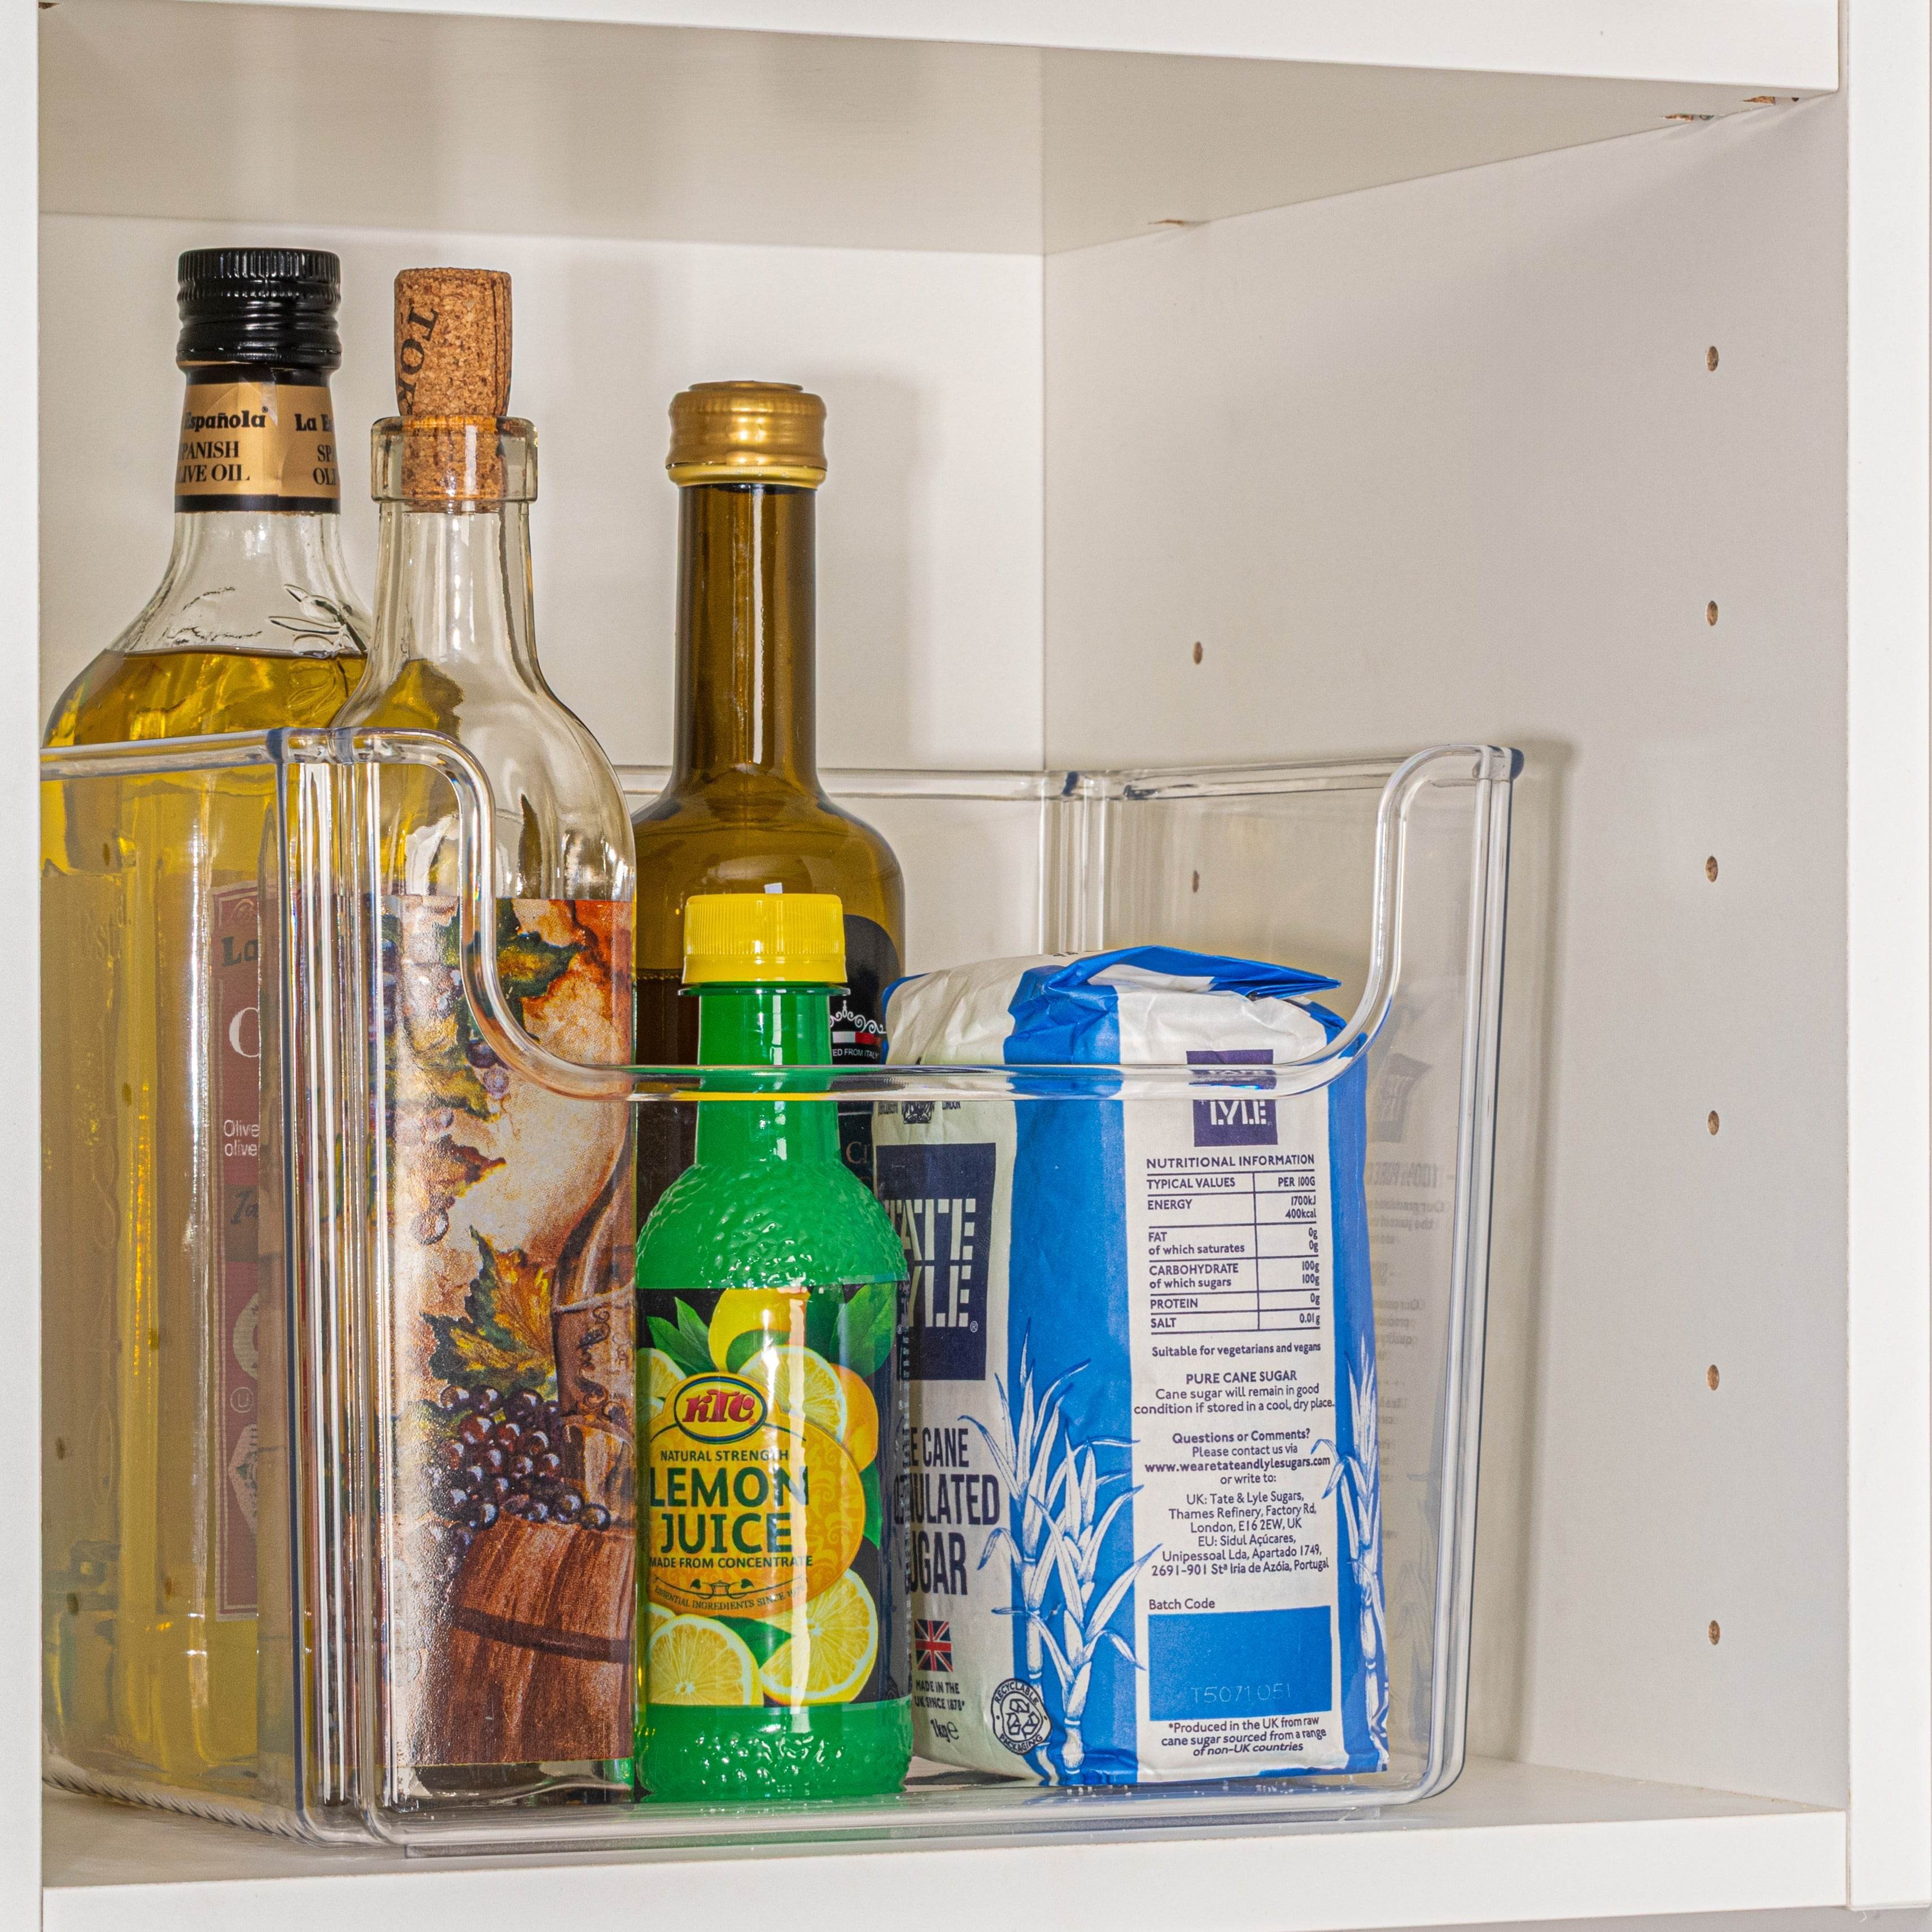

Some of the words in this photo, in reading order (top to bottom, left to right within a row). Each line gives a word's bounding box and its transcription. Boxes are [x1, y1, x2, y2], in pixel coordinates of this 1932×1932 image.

[294, 413, 317, 431] La
[211, 464, 250, 481] OIL
[844, 1048, 864, 1056] FROM
[864, 1050, 878, 1059] ITALY
[1210, 1100, 1266, 1125] LYLE
[1146, 1156, 1236, 1169] NUTRITIONAL
[1239, 1154, 1314, 1166] INFORMATION
[1146, 1178, 1194, 1190] TYPICAL
[1195, 1177, 1235, 1188] VALUES
[1278, 1177, 1295, 1187] PER
[1298, 1176, 1315, 1186] 100G
[1148, 1199, 1192, 1210] ENERGY
[1291, 1195, 1316, 1206] 1700kJ
[1285, 1208, 1317, 1219] 400kcal
[1148, 1231, 1168, 1242] FAT
[1308, 1227, 1318, 1240] 0g
[1148, 1245, 1160, 1256] of
[1162, 1244, 1195, 1255] which
[1197, 1244, 1245, 1254] saturates
[1309, 1240, 1319, 1253] 0g
[1149, 1262, 1239, 1276] CARBOHYDRATE
[1302, 1260, 1319, 1273] 100g
[1149, 1278, 1161, 1289] of
[1164, 1278, 1195, 1288] which
[1198, 1279, 1231, 1290] sugars
[1302, 1273, 1320, 1286] 100g
[1150, 1298, 1198, 1309] PROTEIN
[1310, 1292, 1320, 1306] 0g
[1151, 1317, 1177, 1328] SALT
[1299, 1313, 1320, 1326] 0.01g
[1152, 1345, 1197, 1357] Suitable
[1200, 1345, 1215, 1356] for
[1217, 1344, 1274, 1358] vegetarians
[1276, 1343, 1292, 1353] and
[1293, 1343, 1321, 1355] vegans
[1186, 1372, 1220, 1384] PURE
[1223, 1371, 1257, 1383] CANE
[1259, 1370, 1297, 1382] SUGAR
[1155, 1388, 1187, 1400] Cane
[1190, 1390, 1222, 1402] sugar
[1225, 1386, 1246, 1397] will
[1248, 1388, 1284, 1397] remain
[1296, 1383, 1319, 1398] good
[1134, 1403, 1192, 1414] condition
[1196, 1402, 1204, 1413] if
[1207, 1401, 1244, 1413] stored
[1246, 1401, 1256, 1411] in
[1266, 1399, 1291, 1411] cool,
[1293, 1399, 1309, 1412] dry
[1311, 1398, 1335, 1410] place.
[1172, 1432, 1234, 1444] Questions
[1237, 1433, 1249, 1442] or
[1251, 1428, 1310, 1441] Comments?
[922, 1427, 969, 1467] CANE
[1192, 1446, 1229, 1457] Please
[1231, 1445, 1270, 1456] contact
[1272, 1446, 1283, 1454] us
[661, 1450, 712, 1462] NATURAL
[1144, 1457, 1331, 1472] www.wearetateandlylesugars.com
[650, 1466, 809, 1507] LEMON
[1220, 1476, 1232, 1485] or
[1234, 1474, 1261, 1484] write
[1263, 1474, 1277, 1483] to:
[1186, 1494, 1207, 1505] UK:
[1209, 1493, 1234, 1504] Tate
[1236, 1492, 1244, 1503] &
[1247, 1492, 1268, 1506] Lyle
[1270, 1490, 1304, 1505] Sugars,
[1168, 1508, 1214, 1519] Thames
[1217, 1506, 1264, 1520] Refinery,
[1266, 1505, 1301, 1518] Factory
[1303, 1503, 1317, 1514] Rd,
[1191, 1522, 1236, 1533] London,
[1239, 1520, 1258, 1531] E16
[1260, 1518, 1285, 1531] 2EW,
[1287, 1517, 1302, 1529] UK
[661, 1513, 794, 1554] JUICE
[1198, 1536, 1217, 1547] EU:
[1220, 1535, 1247, 1546] Sidul
[1249, 1533, 1296, 1547] Açúcares,
[1162, 1549, 1226, 1564] Unipessoal
[1229, 1549, 1250, 1560] Lda,
[1252, 1546, 1297, 1563] Apartado
[1300, 1544, 1322, 1556] 1749,
[650, 1557, 676, 1568] MADE
[679, 1557, 715, 1568] FROM
[718, 1555, 812, 1568] CONCENTRATE
[1152, 1564, 1207, 1576] 2691-901
[1230, 1563, 1246, 1574] Iria
[1248, 1562, 1261, 1573] de
[1263, 1561, 1292, 1572] Azóia,
[1294, 1557, 1330, 1572] Portugal
[692, 1600, 754, 1610] INGREDIENTS
[757, 1592, 785, 1606] SINCE
[1149, 1598, 1182, 1610] Batch
[1184, 1597, 1216, 1610] Code
[916, 1680, 934, 1691] MADE
[936, 1682, 943, 1691] IN
[945, 1682, 959, 1694] THE
[995, 1681, 1039, 1705] RECYCLABLE
[914, 1695, 925, 1707] UK
[926, 1697, 946, 1709] SINCE
[1230, 1723, 1240, 1731] in
[1242, 1720, 1260, 1730] the
[1262, 1718, 1279, 1729] UK
[1280, 1717, 1302, 1728] from
[1303, 1717, 1319, 1725] raw
[999, 1733, 1043, 1751] PACKAGING
[1161, 1738, 1188, 1746] cane
[1191, 1736, 1221, 1745] sugar
[1223, 1731, 1267, 1743] sourced
[1269, 1730, 1294, 1741] from
[1302, 1729, 1327, 1741] range
[1194, 1746, 1207, 1756] of
[1207, 1743, 1251, 1755] non-UK
[1252, 1743, 1304, 1752] countries
